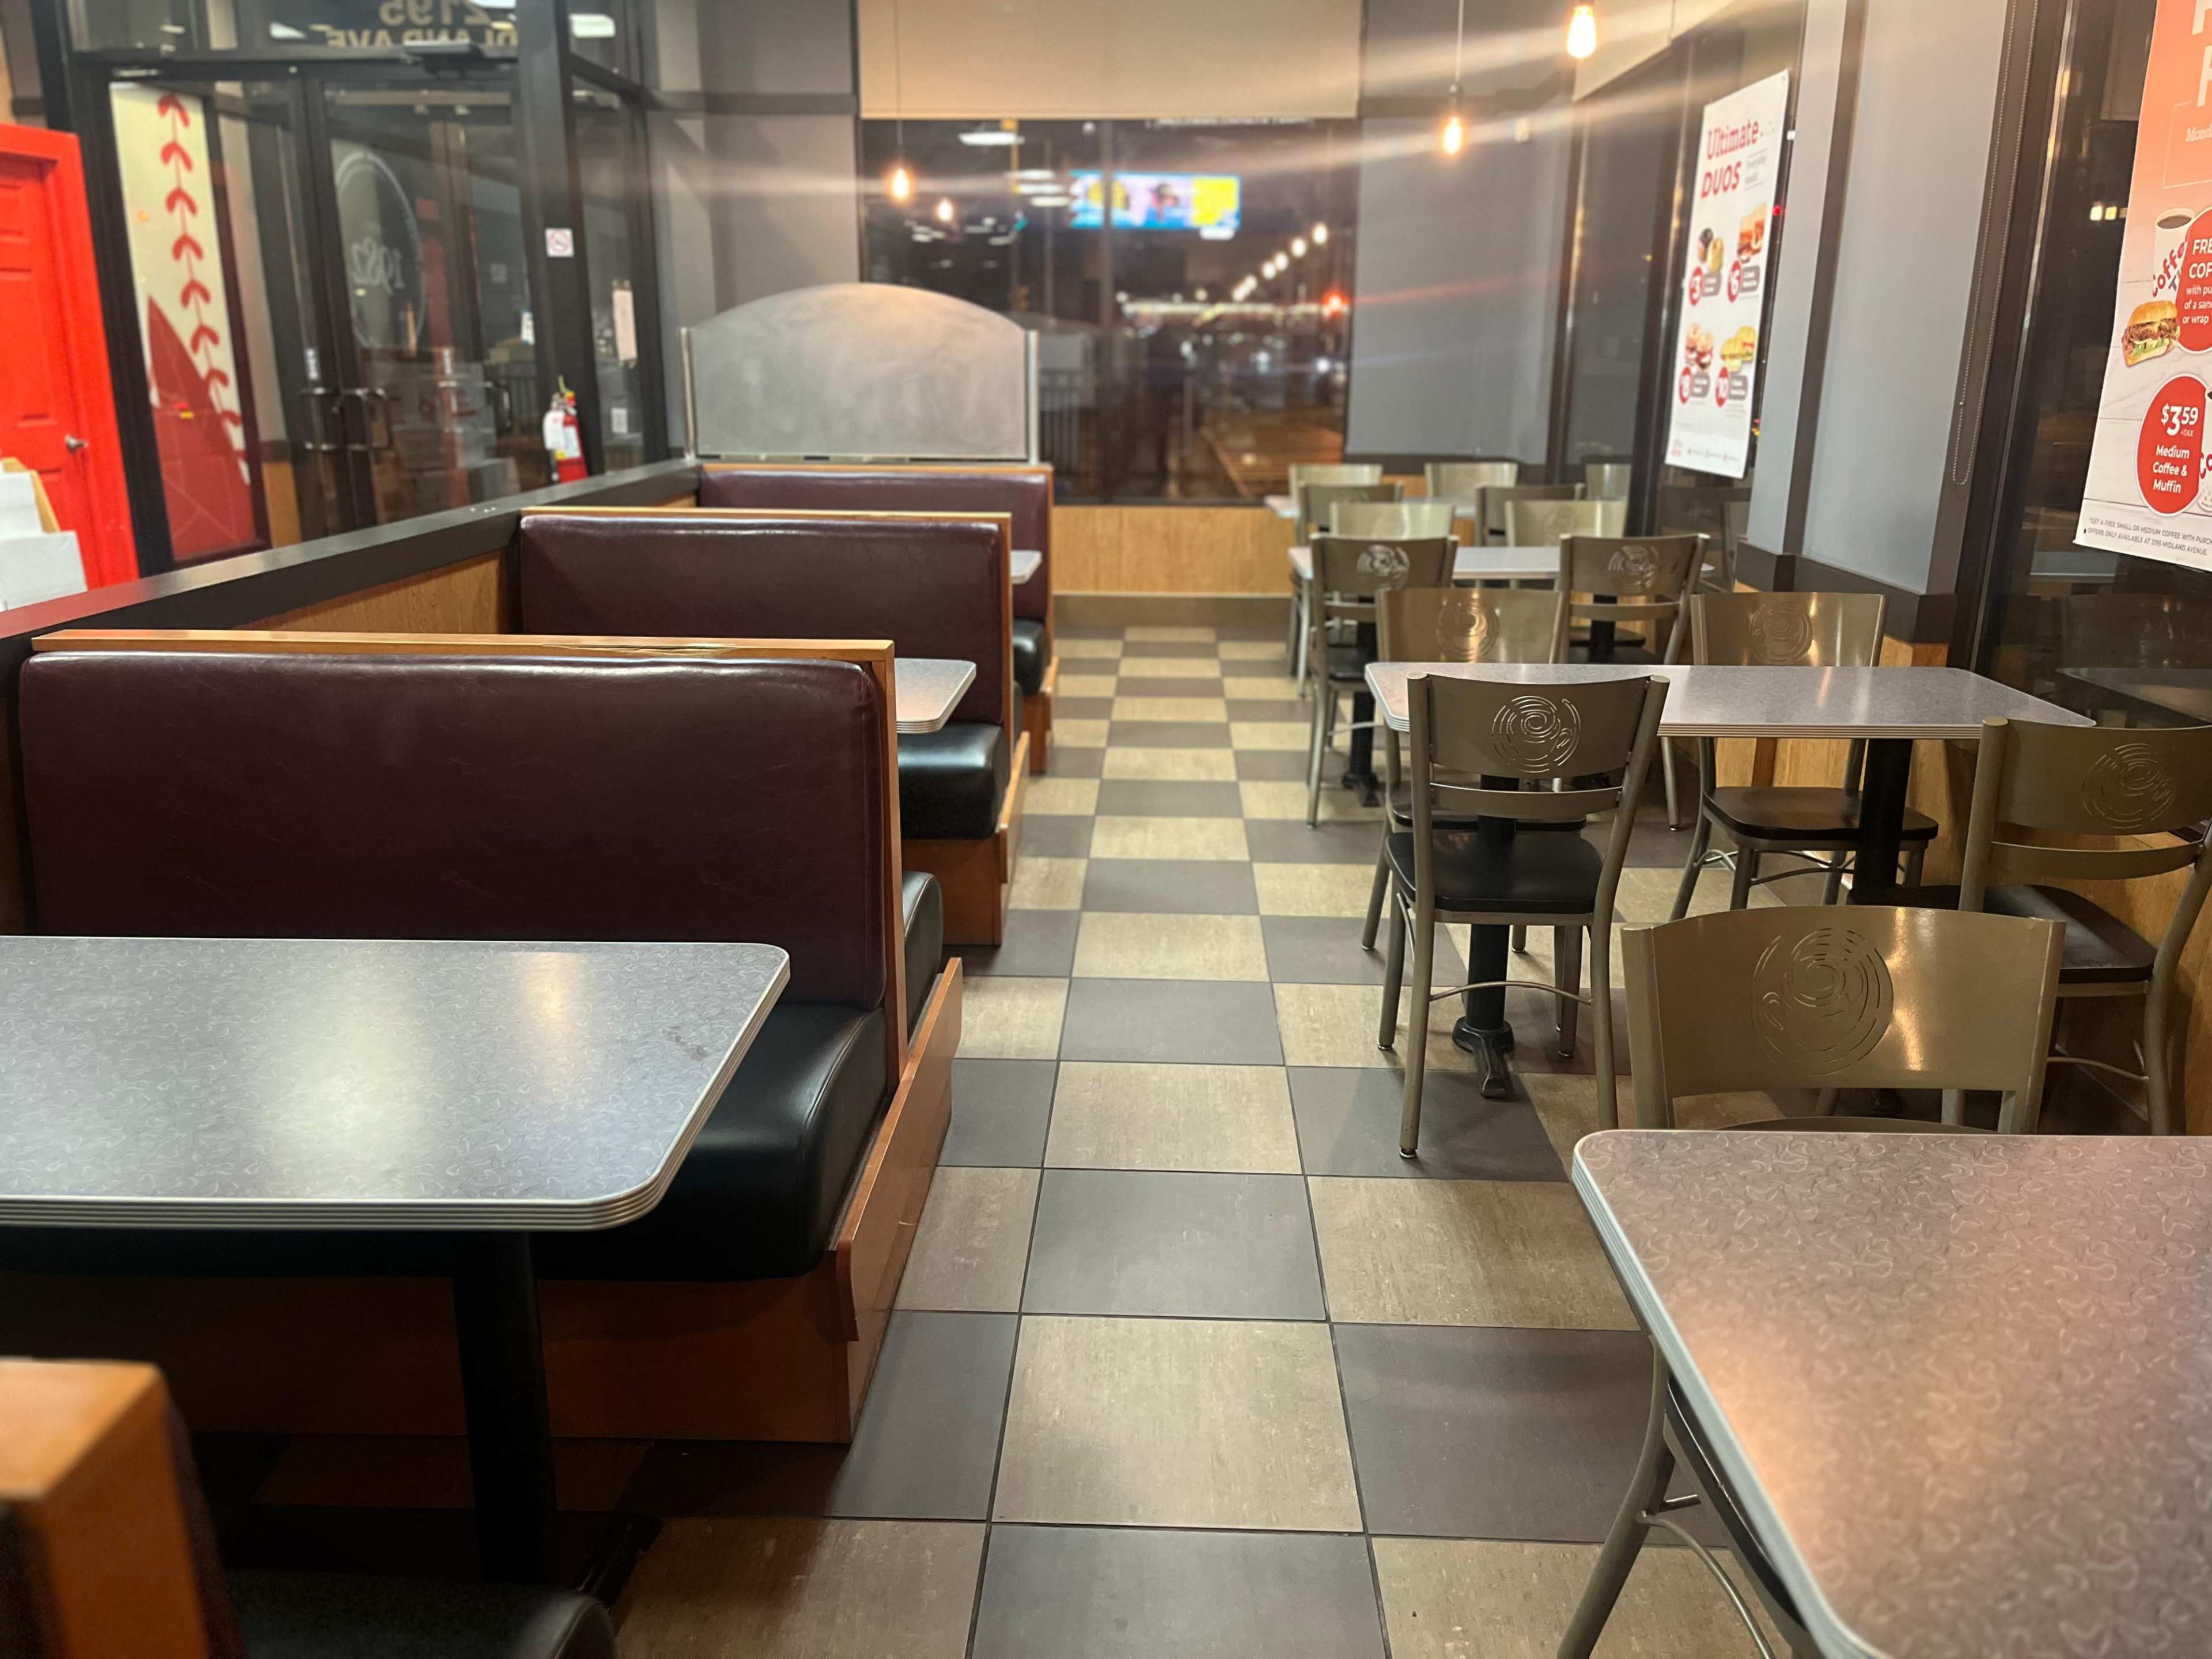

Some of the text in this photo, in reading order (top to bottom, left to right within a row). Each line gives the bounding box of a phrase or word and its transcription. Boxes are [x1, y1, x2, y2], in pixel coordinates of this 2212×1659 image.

[1707, 119, 1759, 160] Ultimate
[1701, 161, 1741, 199] DUOS
[2152, 235, 2187, 298] Coffe
[2186, 285, 2201, 295] with
[2184, 299, 2191, 309] of
[2182, 315, 2209, 325] or wrap
[2156, 444, 2190, 459] Medium
[2153, 461, 2188, 476] Coffee &
[2153, 478, 2181, 493] Muffin
[2104, 520, 2116, 528] FREE
[2117, 521, 2131, 531] SMALL
[2141, 525, 2161, 535] MEDIUM
[2162, 529, 2181, 539] COFFEE
[2181, 533, 2195, 541] WITH
[2088, 527, 2104, 536] OFFERS
[2105, 530, 2118, 538] ONLY
[2118, 532, 2143, 543] AVAILABLE
[2152, 539, 2161, 547] 2195
[2162, 541, 2186, 551] MIDLAND
